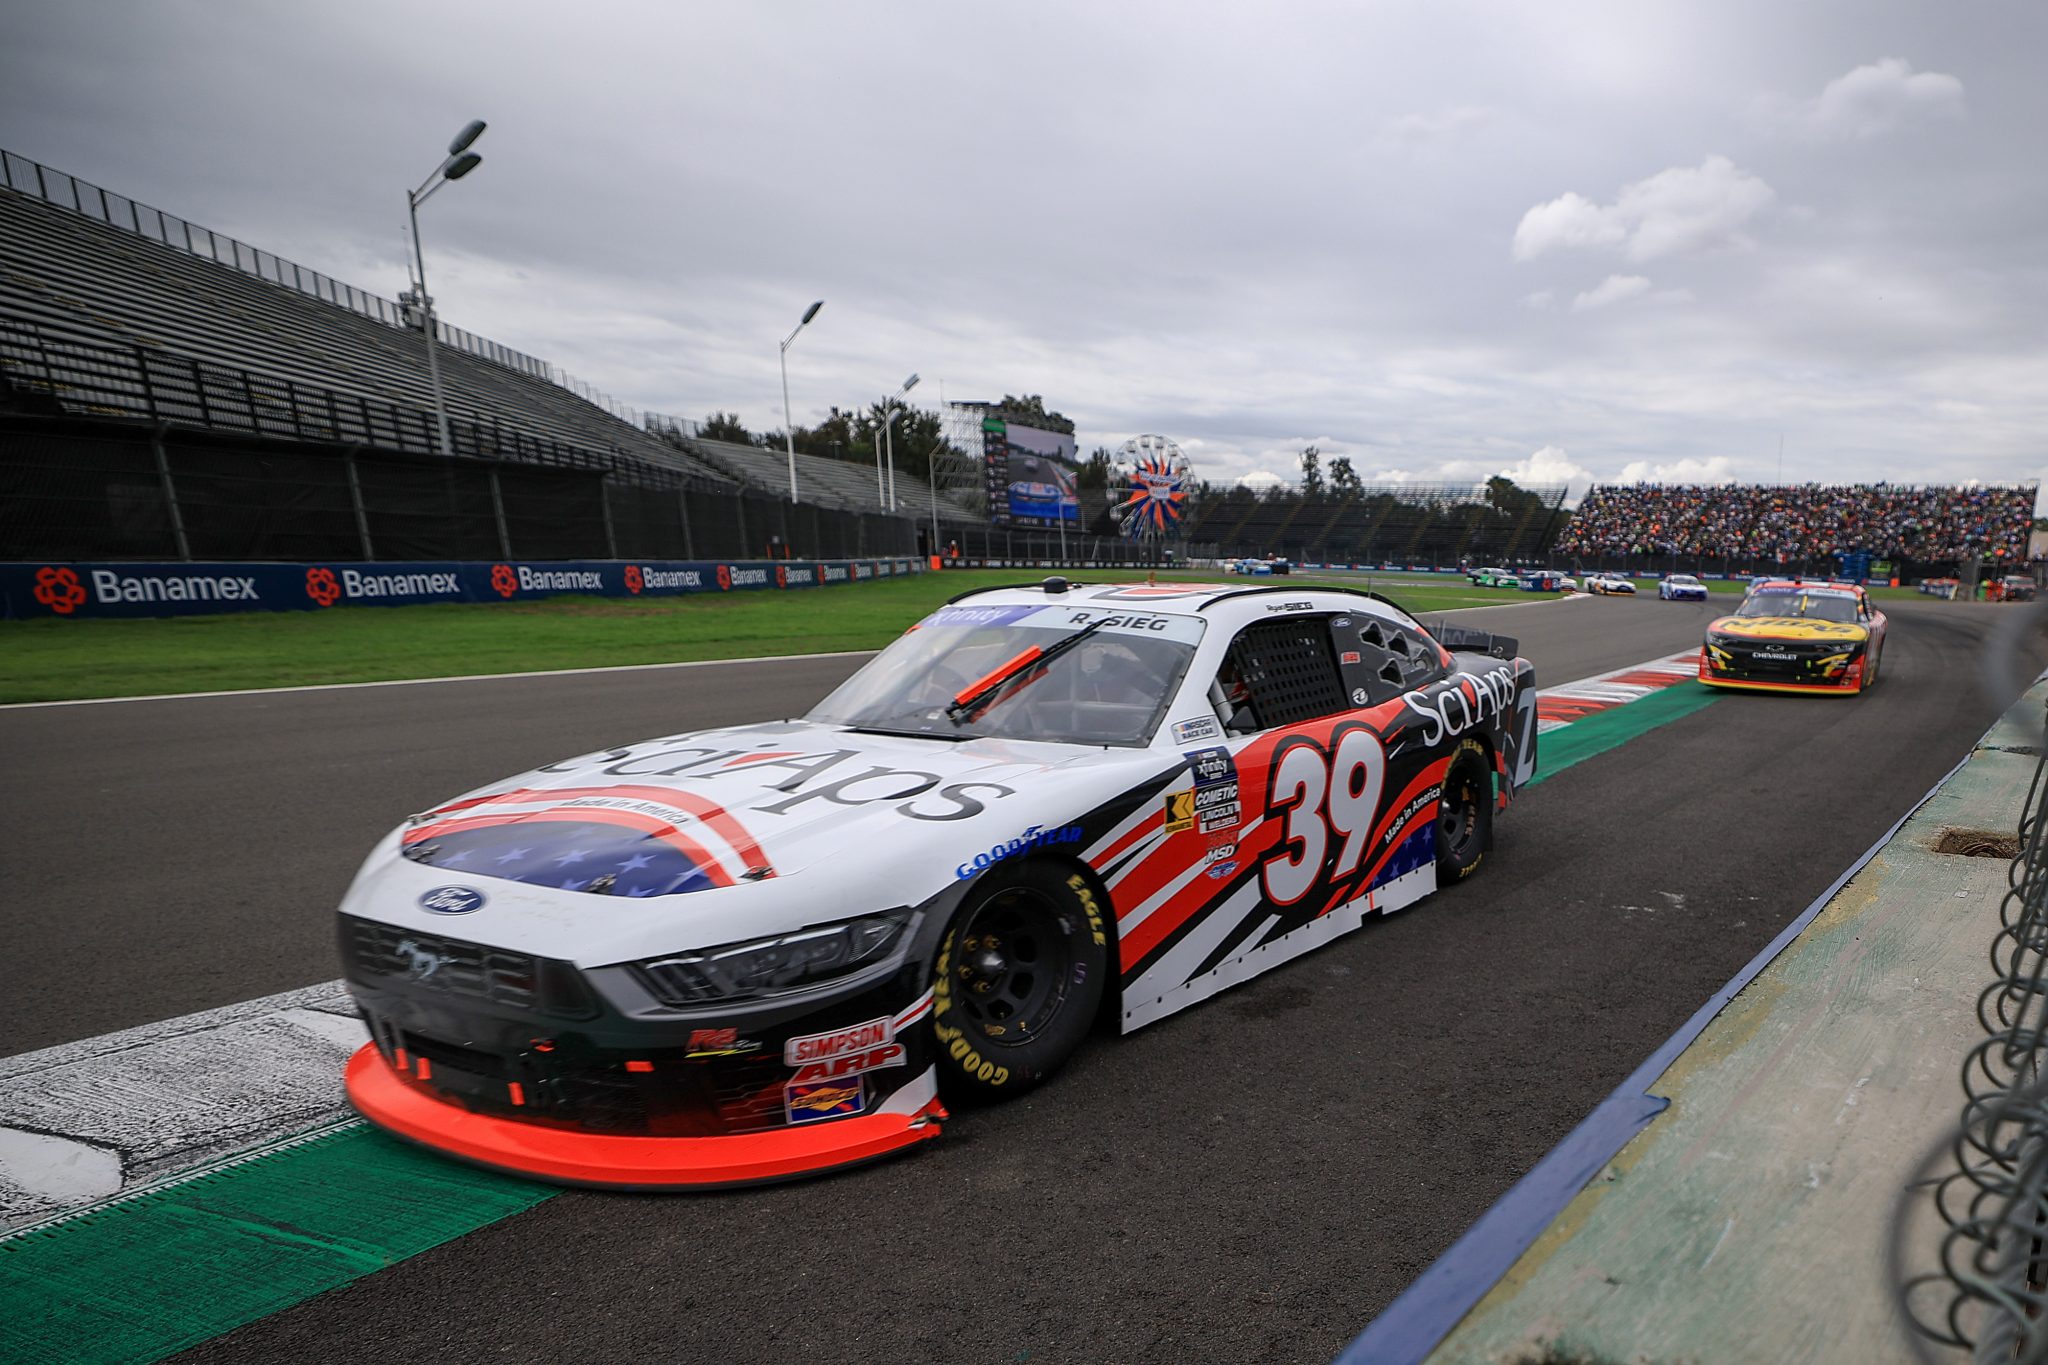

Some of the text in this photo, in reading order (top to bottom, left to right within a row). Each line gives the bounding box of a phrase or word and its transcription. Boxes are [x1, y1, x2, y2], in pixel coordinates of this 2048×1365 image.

[91, 569, 260, 603] Banamex
[341, 569, 460, 598] Banamex
[517, 565, 603, 590] Banamex
[643, 565, 701, 589] Banamex
[729, 565, 768, 585] Banamex
[1285, 601, 1314, 611] SIEG
[1109, 615, 1169, 631] SIEG
[1752, 651, 1798, 661] CHEVROLET
[1182, 727, 1214, 739] RACE CAR
[1197, 757, 1228, 777] xfinity
[1196, 784, 1238, 806] COMETIC
[631, 801, 691, 825] America
[1201, 804, 1234, 822] LINCOLN
[1264, 728, 1385, 905] 39
[1385, 817, 1405, 843] Made
[1412, 786, 1442, 815] America
[954, 824, 1084, 881] GOODYEAR
[1205, 844, 1235, 865] MSD
[423, 886, 480, 912] Ford
[795, 1021, 886, 1062] SIMPSON
[788, 1043, 905, 1083] ARP
